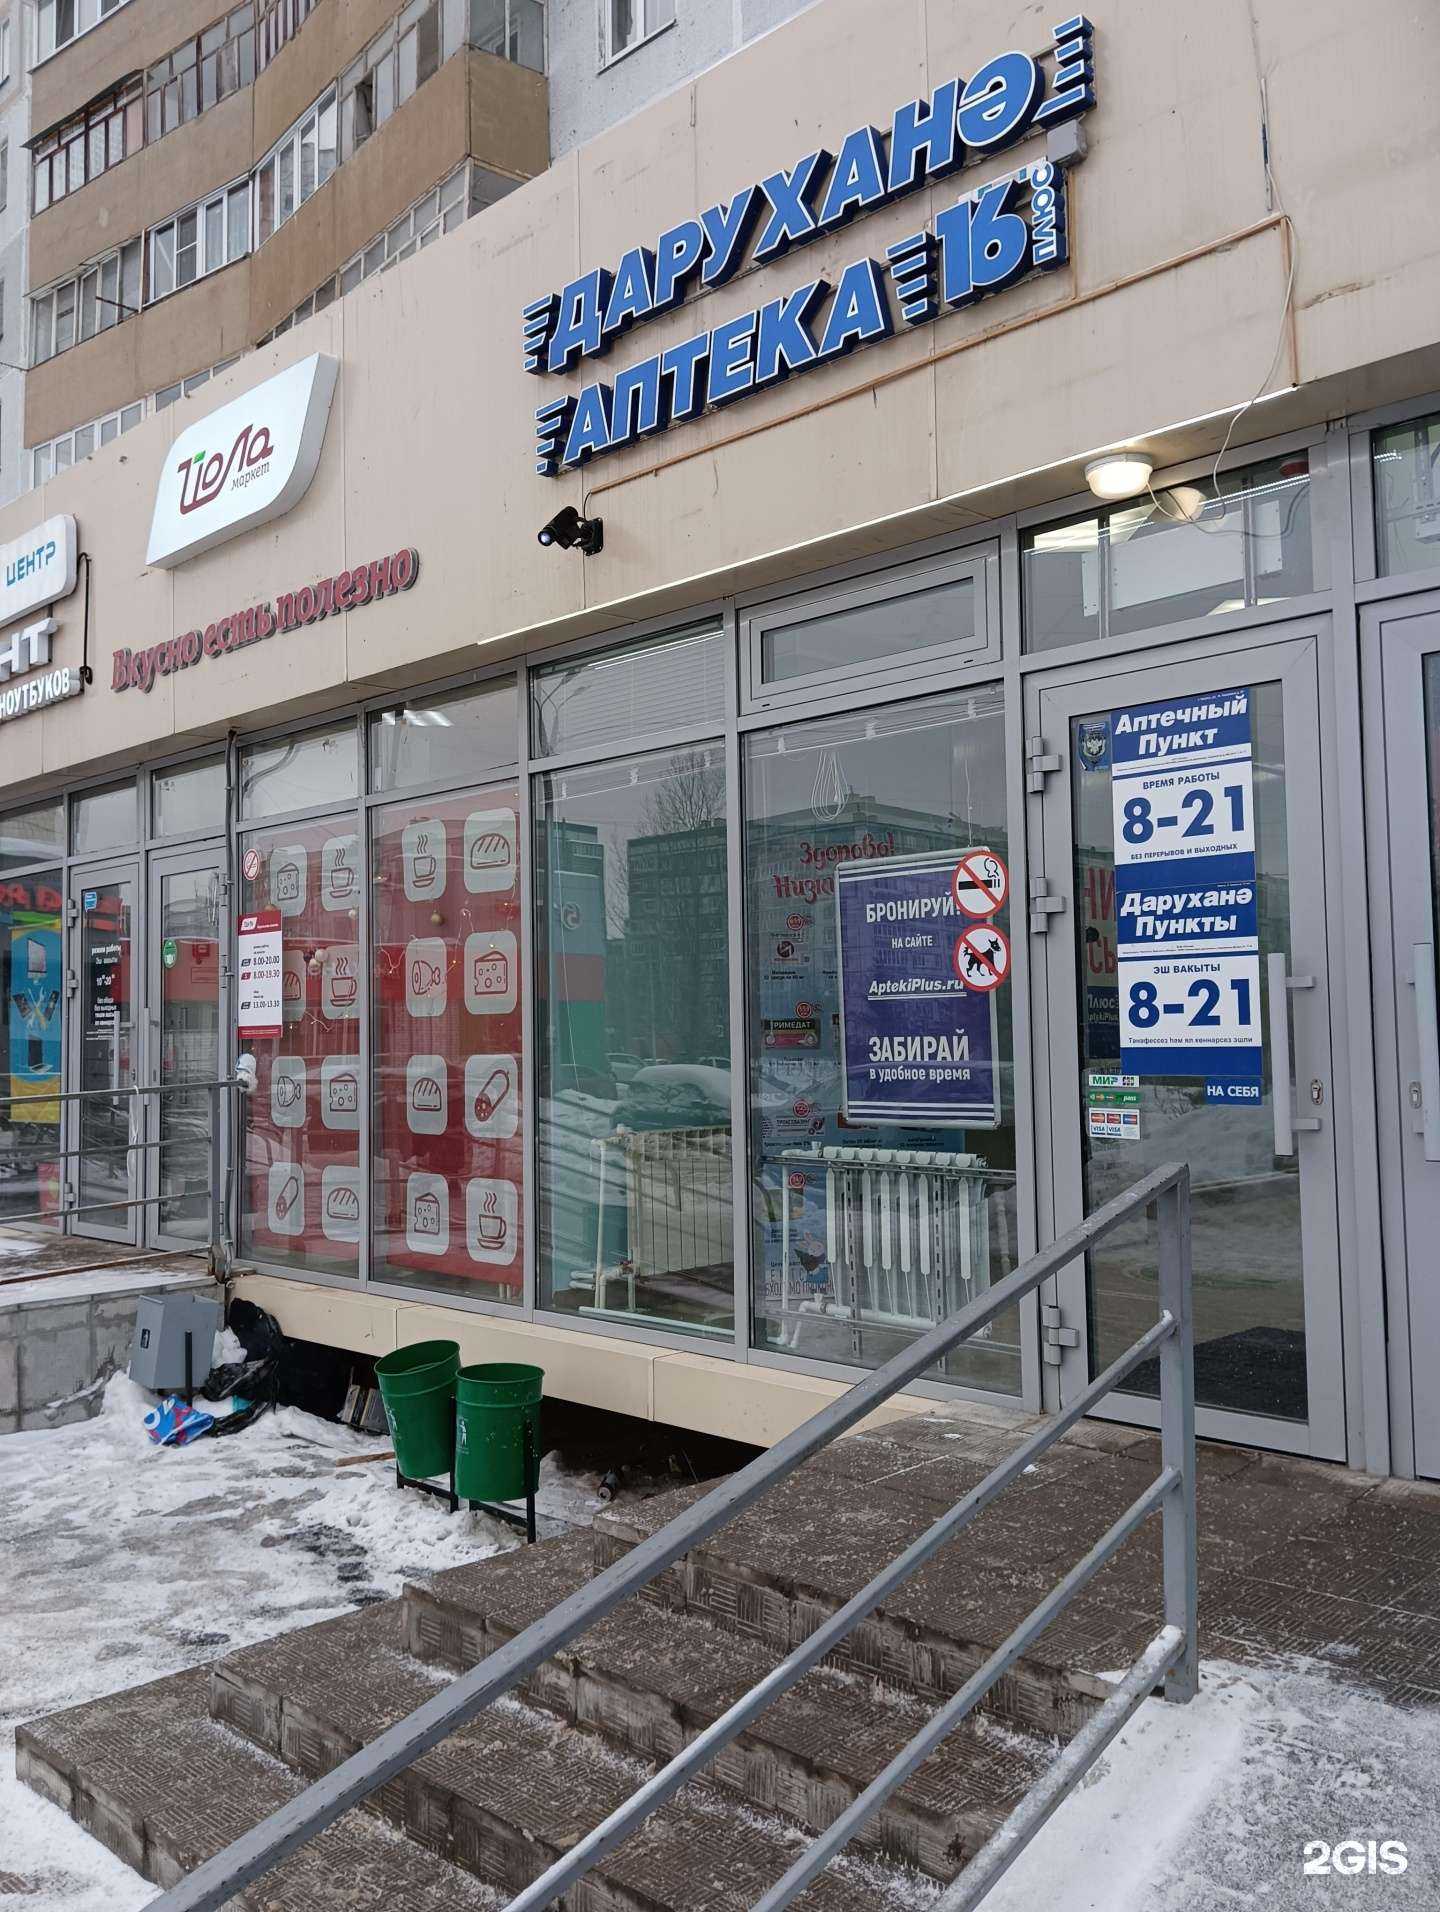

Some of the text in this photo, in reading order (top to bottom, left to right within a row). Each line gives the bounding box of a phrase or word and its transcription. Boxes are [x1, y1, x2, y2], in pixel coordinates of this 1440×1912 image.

[548, 50, 1038, 373] ДАРУХАНӘ
[562, 180, 1027, 466] АПТЕКА 16
[6, 541, 56, 587] ЦЕНТР
[111, 547, 420, 692] Вкусно есть полезно
[1115, 694, 1247, 735] Аптечный
[1138, 728, 1218, 757] Пункт
[1143, 772, 1220, 790] ВРЕМЯ РАБОТЫ
[1122, 785, 1245, 844] 8-21
[1120, 888, 1253, 917] Даруханә
[891, 935, 933, 949] НА САЙТЕ
[1136, 915, 1237, 940] Пункты
[1153, 964, 1221, 974] ЭШ ВАКЫТЫ
[869, 977, 965, 995] AptekiPlus.ru
[1128, 978, 1252, 1028] 8-21
[868, 1029, 970, 1062] ЗАБИРАЙ
[869, 1066, 970, 1082] в удобное время
[1092, 1076, 1119, 1085] МИР
[1207, 1085, 1259, 1097] НА СЕБЯ
